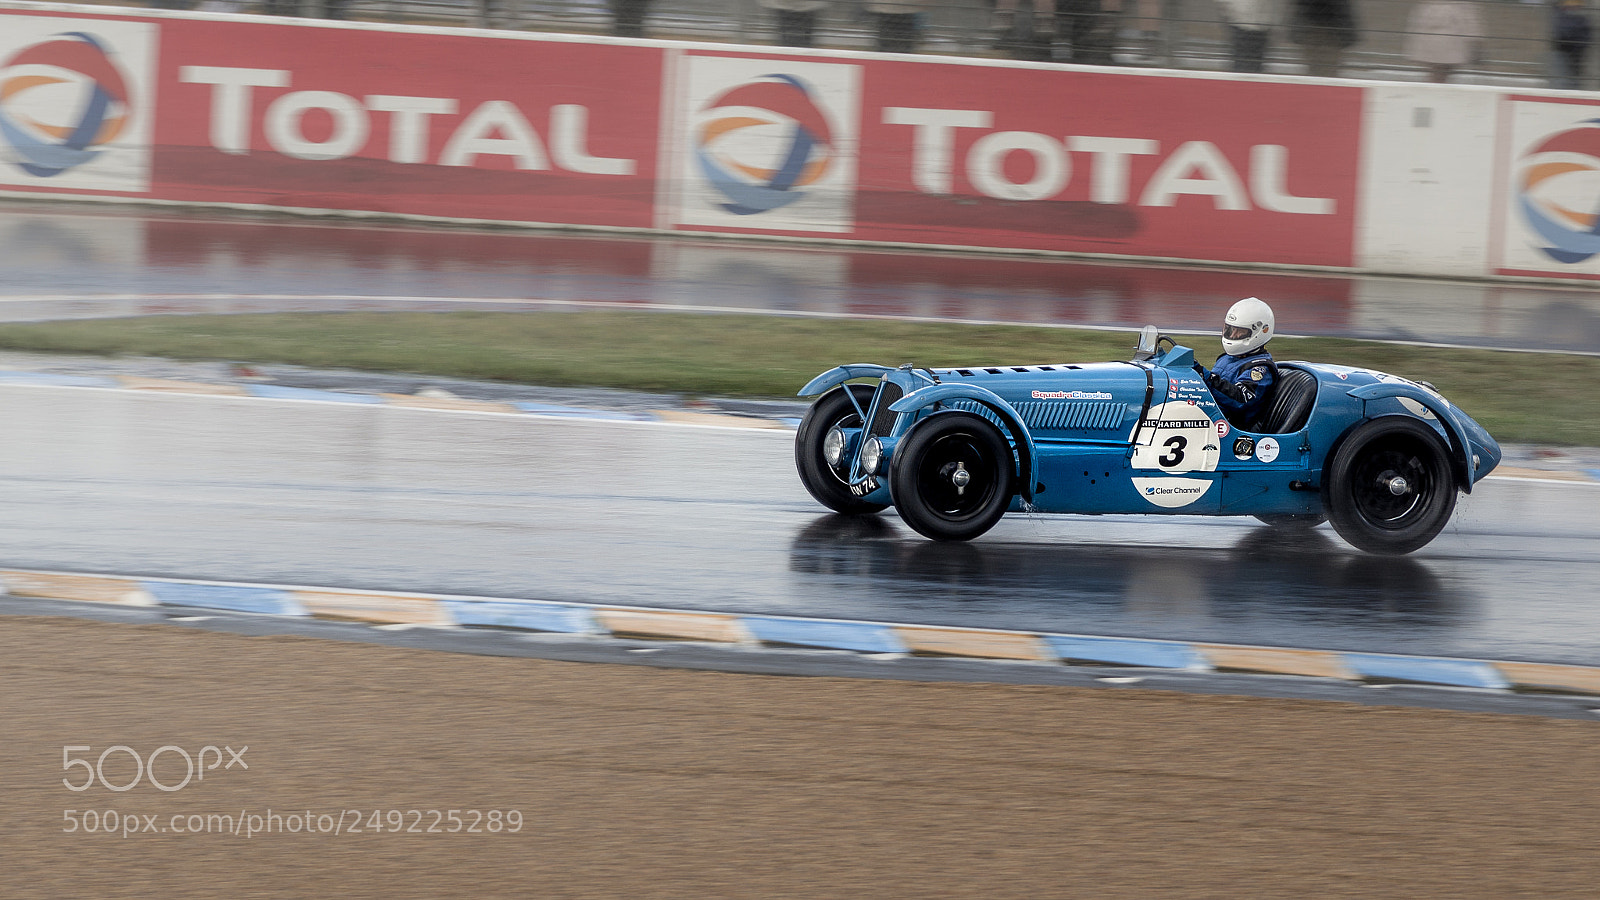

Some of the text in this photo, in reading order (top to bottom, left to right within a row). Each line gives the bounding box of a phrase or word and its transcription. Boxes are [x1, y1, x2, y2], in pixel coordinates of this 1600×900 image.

[179, 65, 637, 176] TOTAL
[882, 107, 1336, 215] TOTAL
[1032, 391, 1112, 400] SquadraClassica
[1217, 424, 1225, 434] E
[1158, 435, 1188, 468] 3
[862, 476, 876, 493] 74
[1155, 486, 1201, 495] Clear Channel
